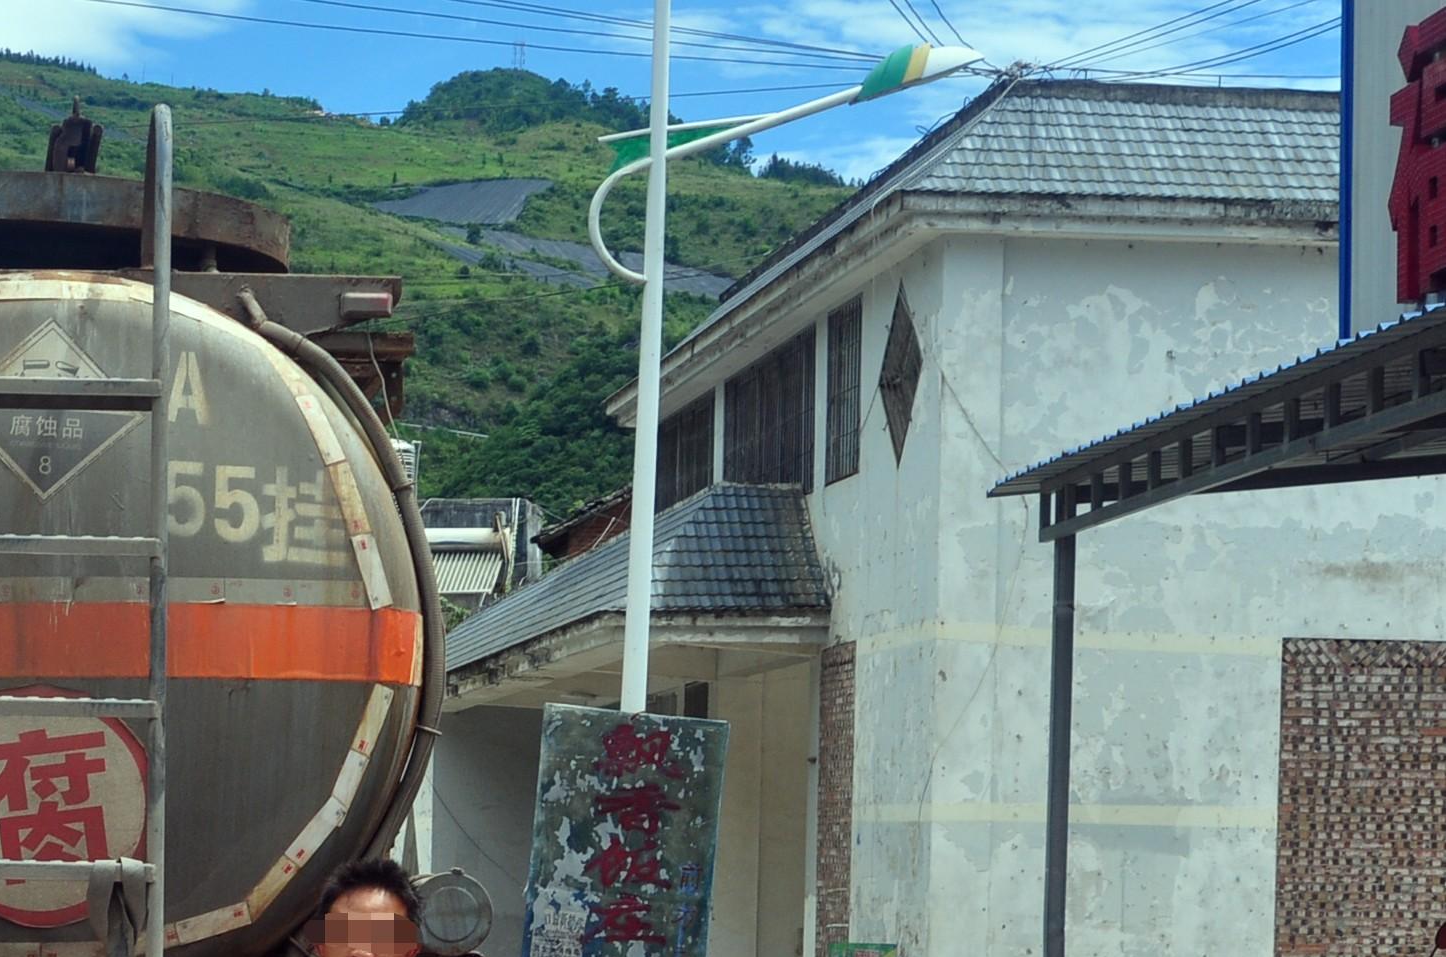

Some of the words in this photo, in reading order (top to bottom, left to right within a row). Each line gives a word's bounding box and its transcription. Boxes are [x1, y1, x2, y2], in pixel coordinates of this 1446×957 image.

[167, 351, 208, 425] A
[10, 415, 83, 440] 腐蚀品
[38, 455, 52, 475] 8
